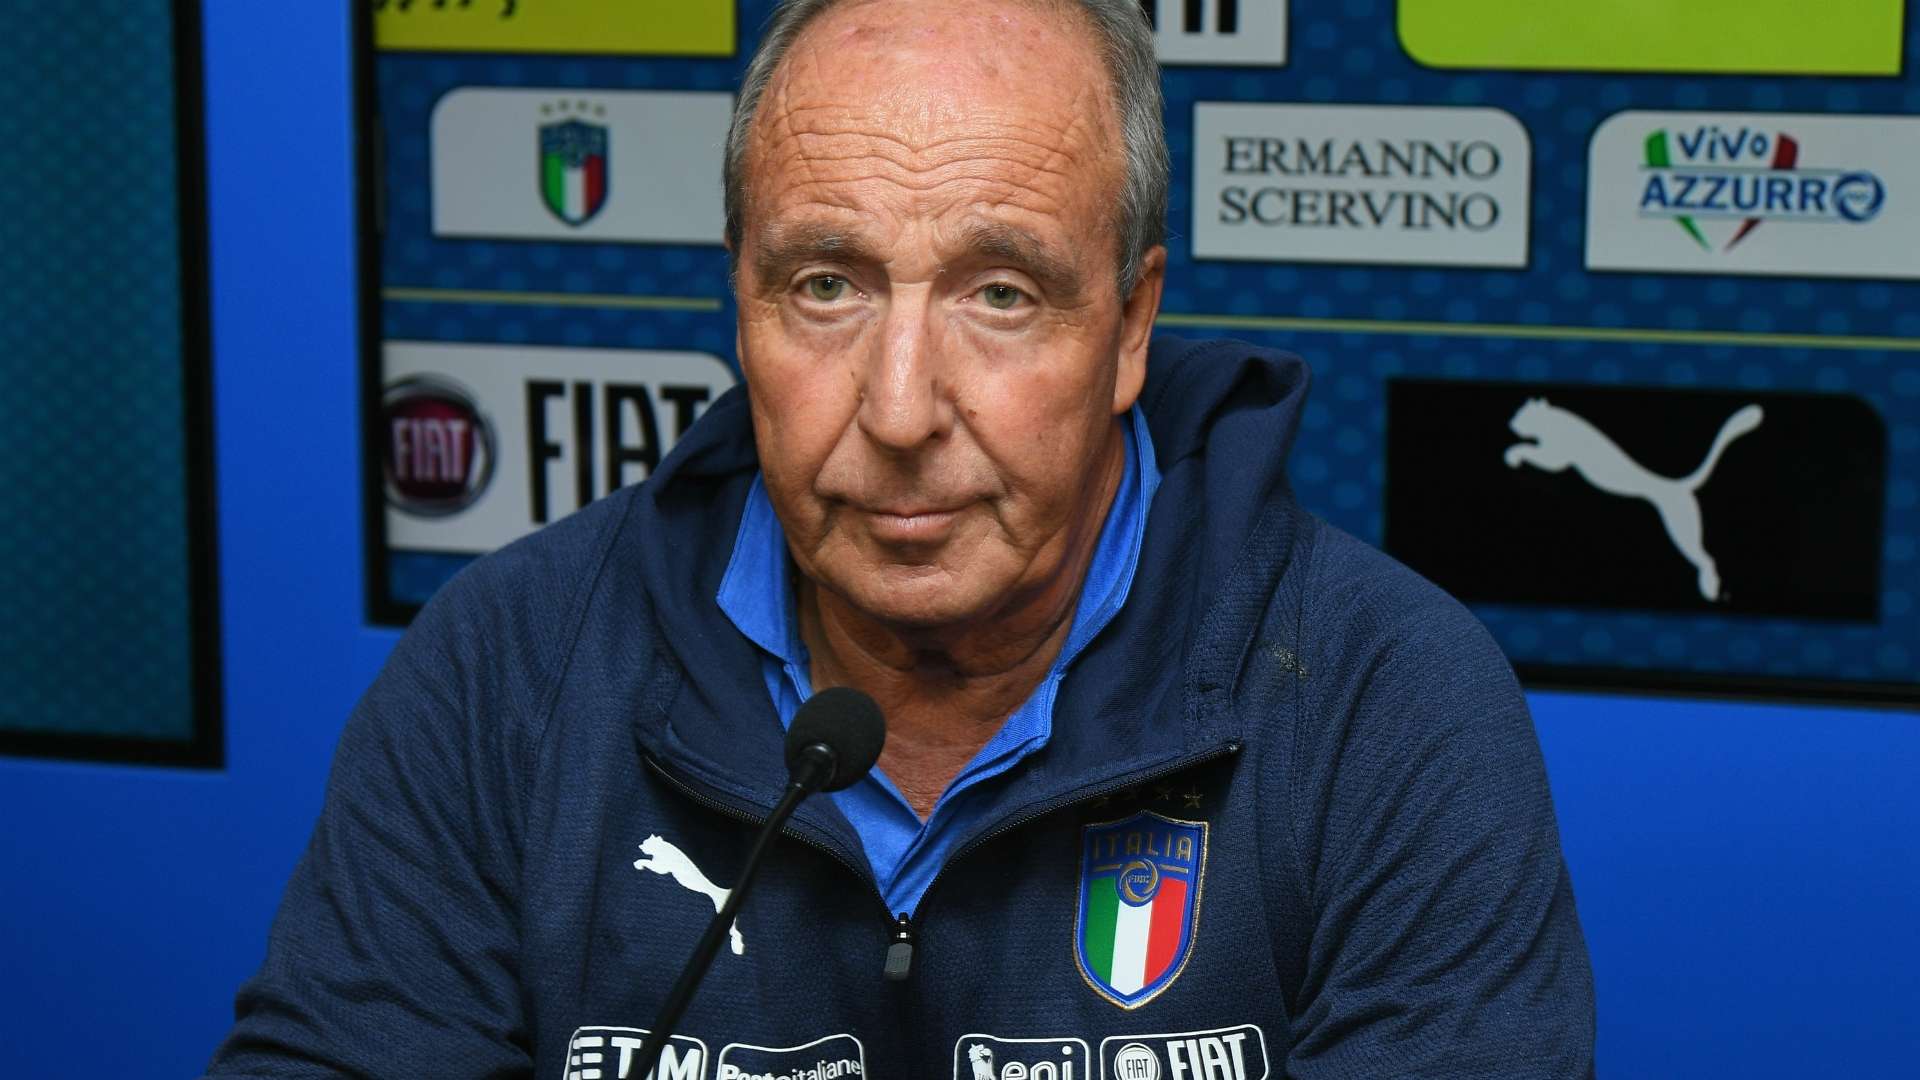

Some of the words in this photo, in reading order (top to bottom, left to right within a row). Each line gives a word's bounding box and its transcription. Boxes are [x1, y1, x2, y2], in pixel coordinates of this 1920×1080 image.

[1223, 136, 1501, 180] ERMANNO
[1219, 187, 1499, 231] SCERVINO
[391, 418, 468, 484] FIAT
[1094, 831, 1191, 861] ITALIA
[611, 1036, 701, 1080] TM
[1001, 1045, 1073, 1080] eni
[1126, 1058, 1150, 1079] FIAT
[1166, 1033, 1246, 1080] FIAT
